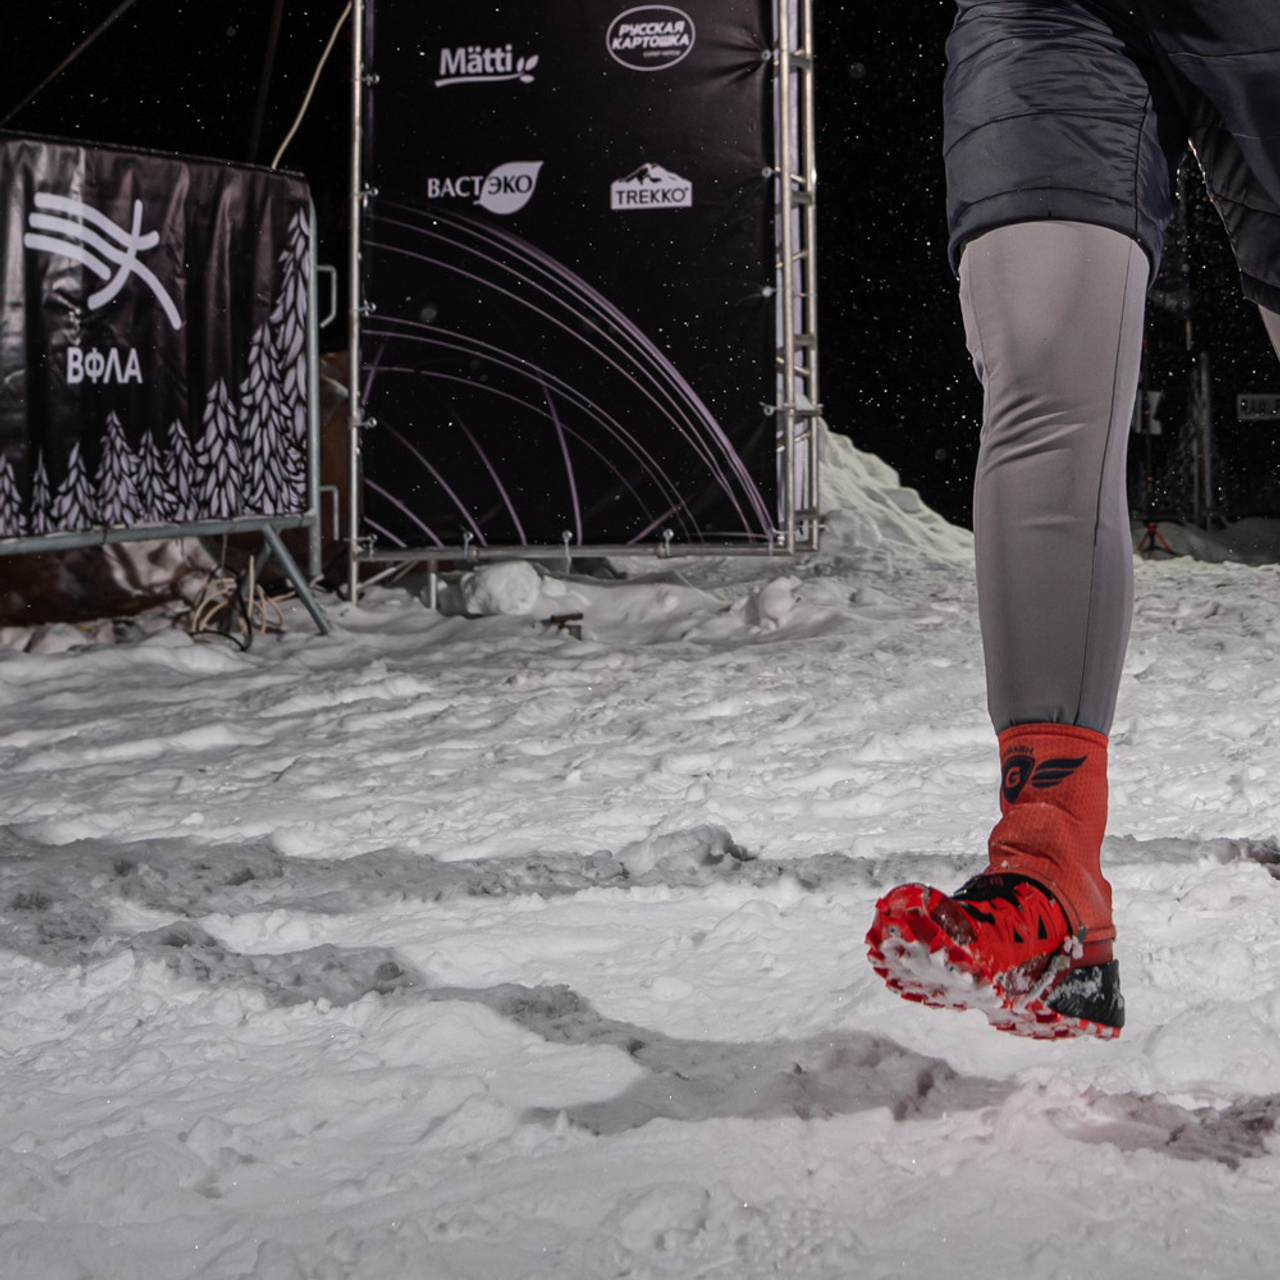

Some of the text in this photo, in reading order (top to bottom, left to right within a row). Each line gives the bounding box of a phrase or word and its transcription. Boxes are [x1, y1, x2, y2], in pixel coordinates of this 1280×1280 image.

[619, 21, 686, 37] РУССКАЯ
[611, 33, 690, 50] КАРТОШКА
[440, 44, 513, 75] Mätti
[616, 188, 685, 205] TREKKO
[1005, 766, 1022, 788] G
